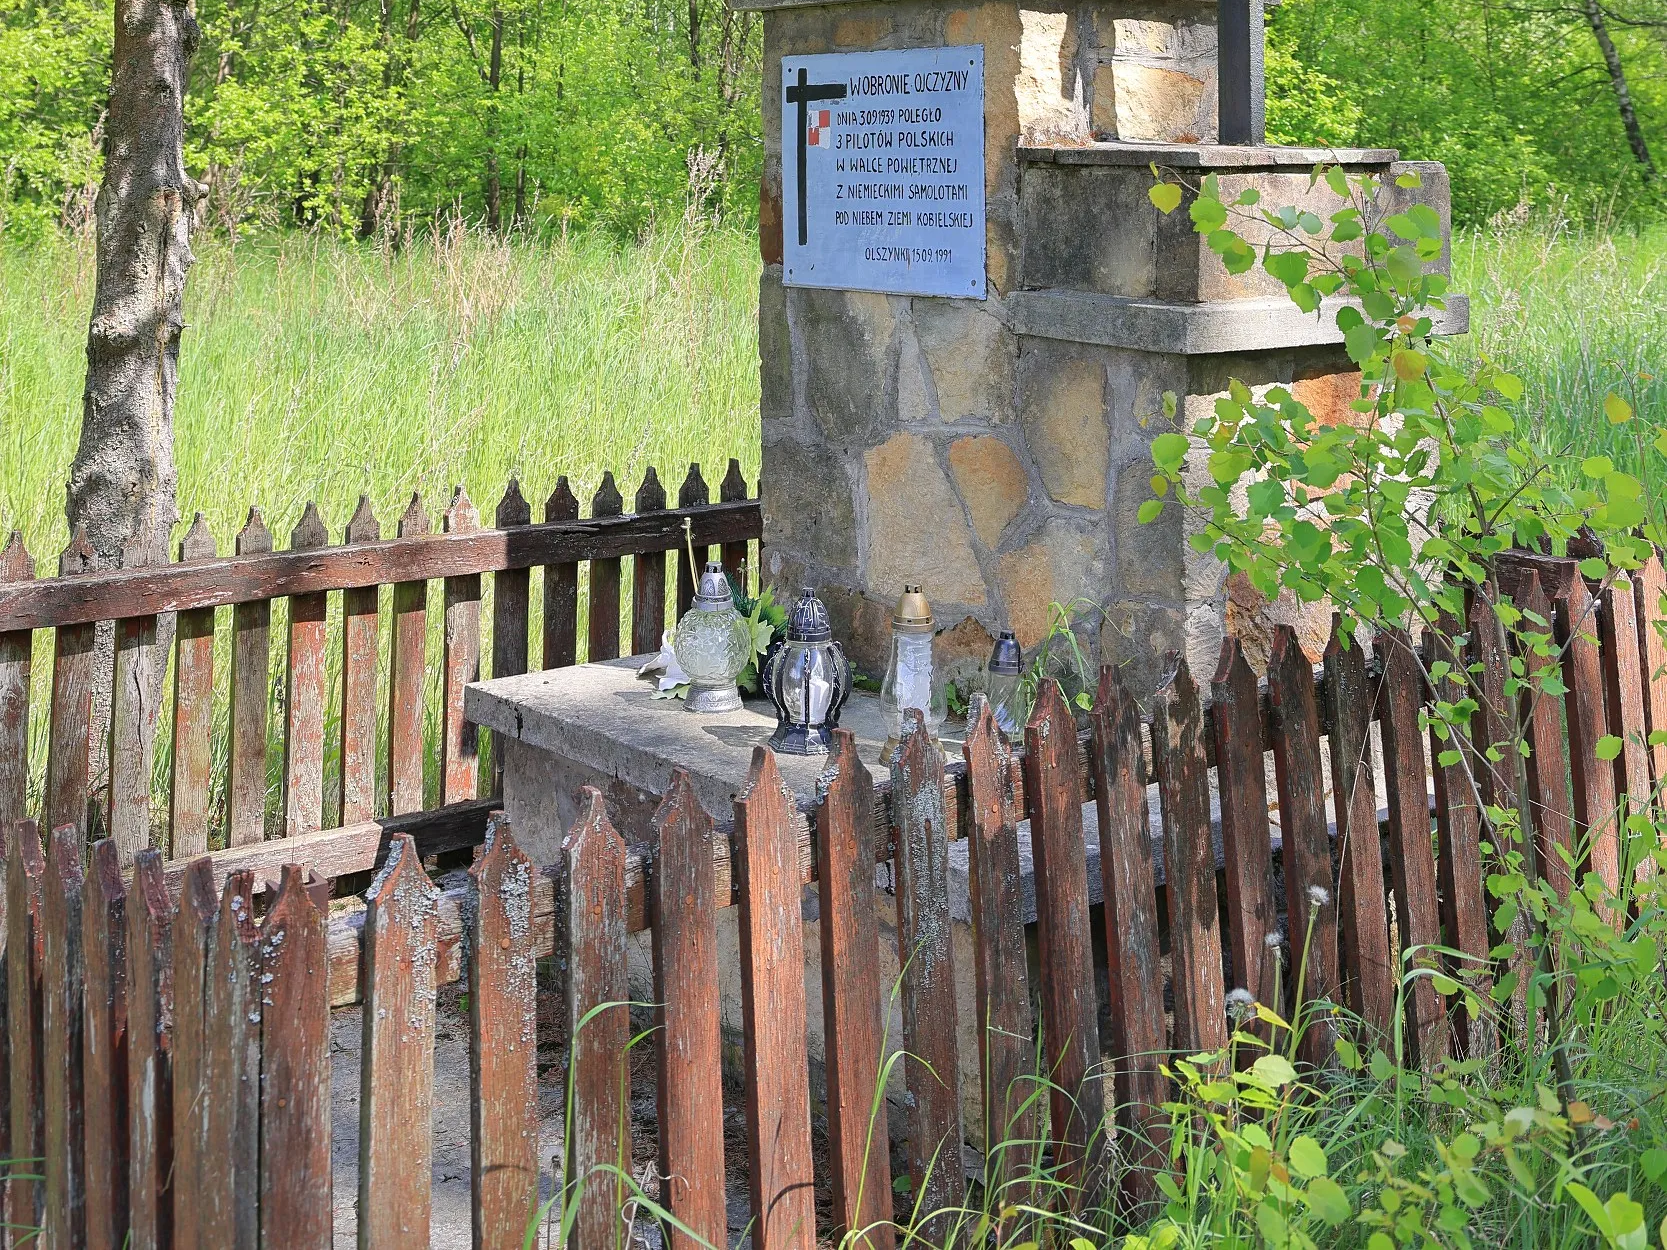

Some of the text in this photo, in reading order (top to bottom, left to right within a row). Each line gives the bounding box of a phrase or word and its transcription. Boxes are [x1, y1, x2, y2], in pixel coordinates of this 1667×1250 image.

[914, 70, 969, 93] OJCZYZNY
[837, 111, 858, 126] DNIA
[898, 107, 942, 124] POLEGŁO
[836, 130, 954, 150] 3 PILOTÓW POLSKICH
[836, 158, 845, 172] W
[850, 157, 884, 173] WALCE
[836, 183, 968, 201] Z NIEMIECKIMI SAMOLOTAMI
[835, 210, 973, 229] POD NIEBEM ZIEMI KOBIELSKIEJ
